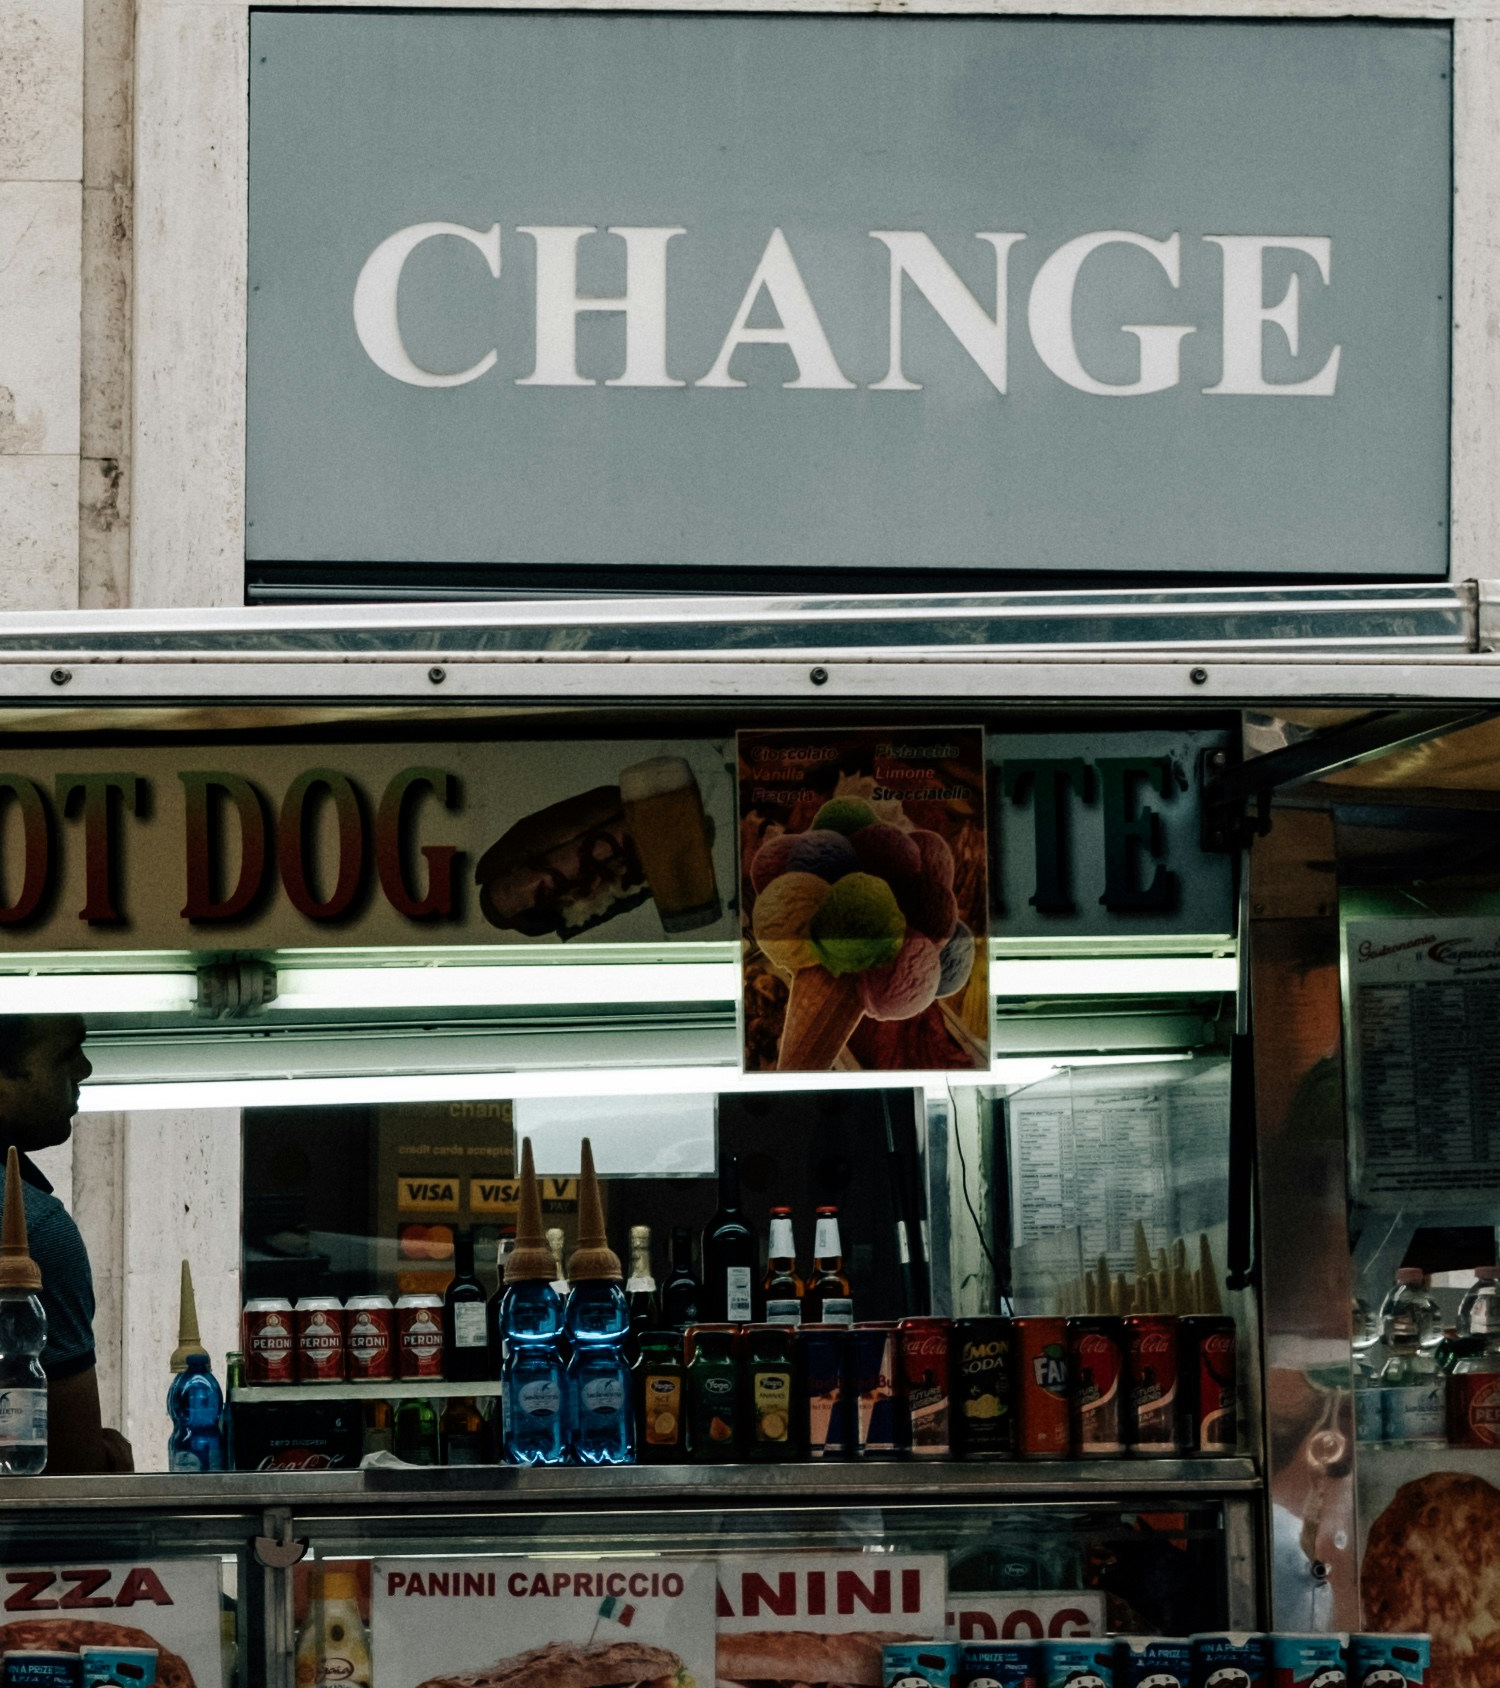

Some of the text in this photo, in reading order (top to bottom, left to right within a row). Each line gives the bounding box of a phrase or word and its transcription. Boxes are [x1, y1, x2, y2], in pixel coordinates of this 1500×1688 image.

[352, 222, 1341, 397] CHANGE
[750, 745, 839, 762] Cioccolato
[751, 767, 805, 782] Vanilla
[875, 767, 935, 780] Limone
[872, 786, 972, 801] Stracciatella
[180, 768, 467, 926] DOG
[407, 1183, 454, 1201] VISA
[300, 1336, 340, 1348] PERONI
[403, 1334, 443, 1345] PERONI
[386, 1571, 684, 1599] PANINI CAPRICCIO
